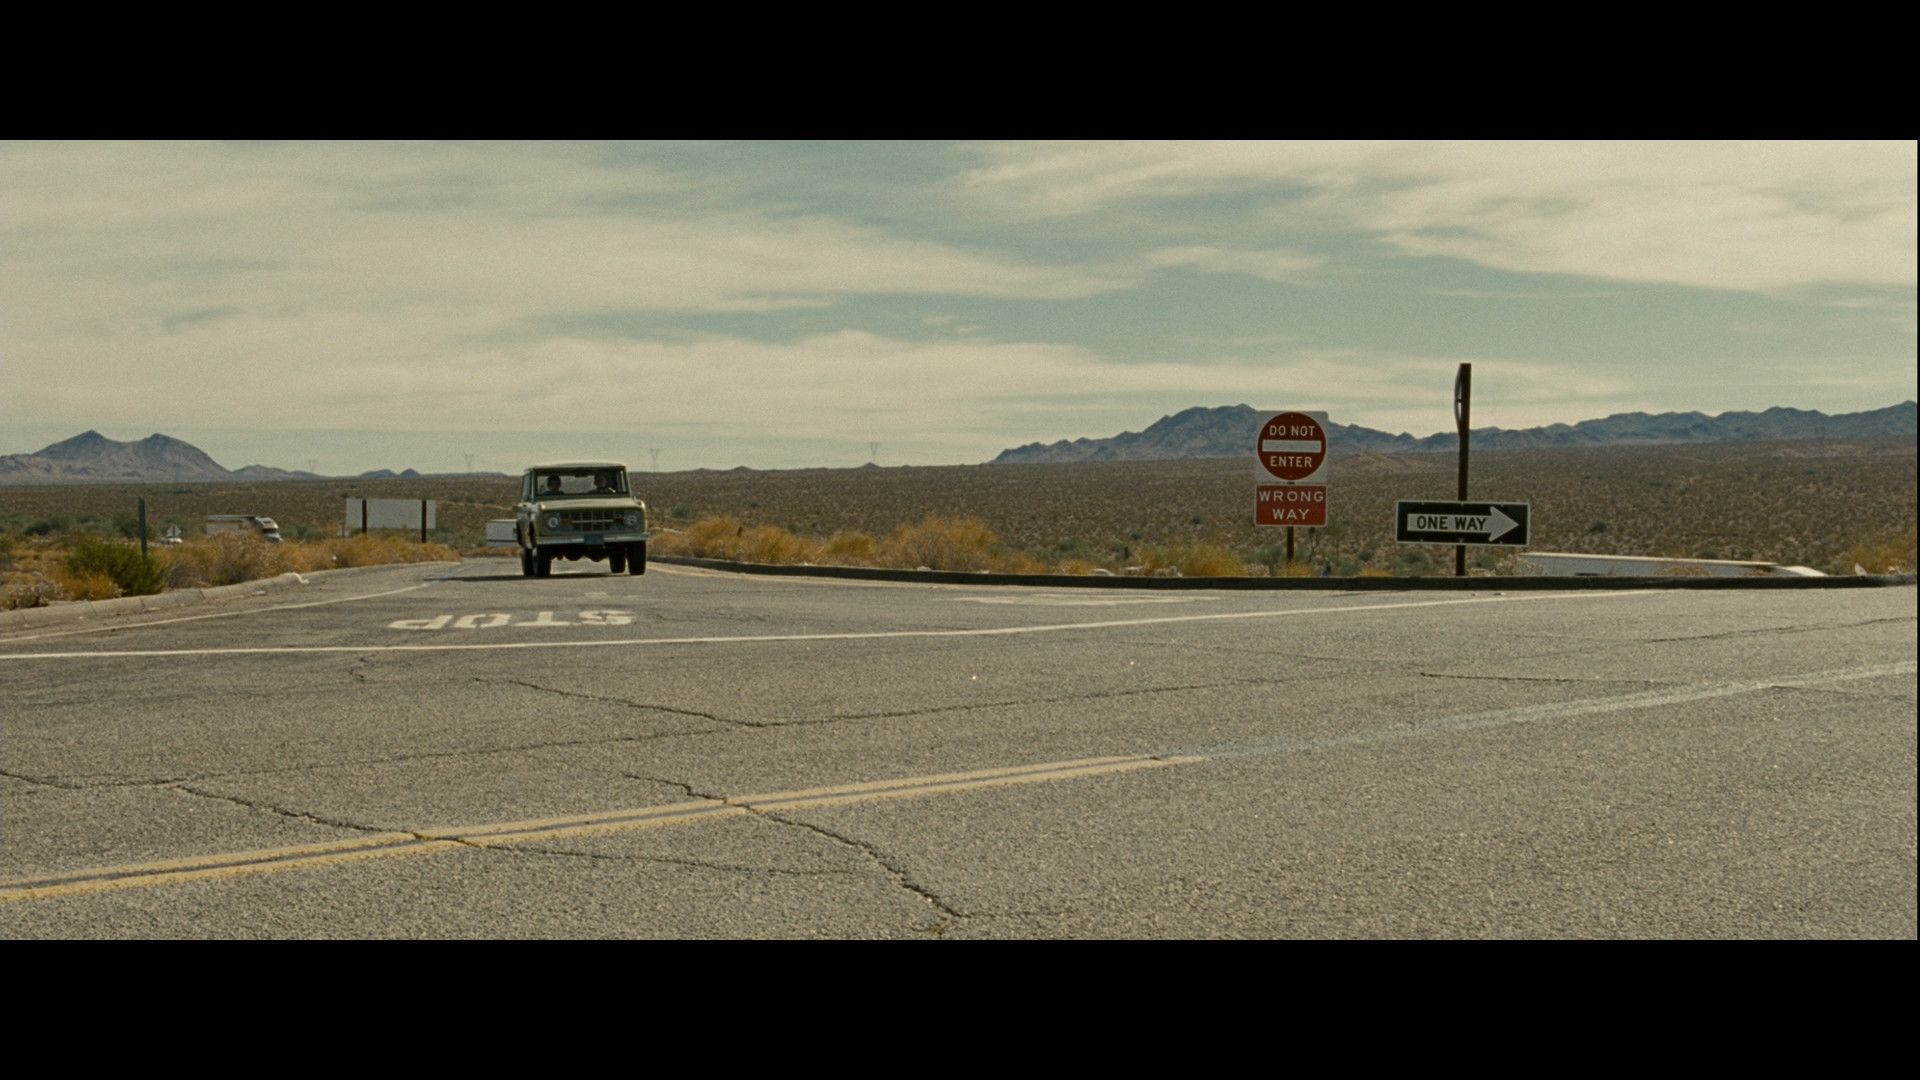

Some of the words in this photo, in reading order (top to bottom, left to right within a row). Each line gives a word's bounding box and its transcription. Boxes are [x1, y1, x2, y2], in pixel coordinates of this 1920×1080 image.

[1269, 425, 1286, 437] DO
[1290, 425, 1315, 437] NOT
[1269, 455, 1313, 468] ENTER
[1258, 490, 1325, 503] WRONG
[1272, 508, 1310, 520] WAY
[1416, 515, 1449, 530] ONE
[1454, 516, 1488, 531] WAY
[387, 610, 635, 630] STOP
